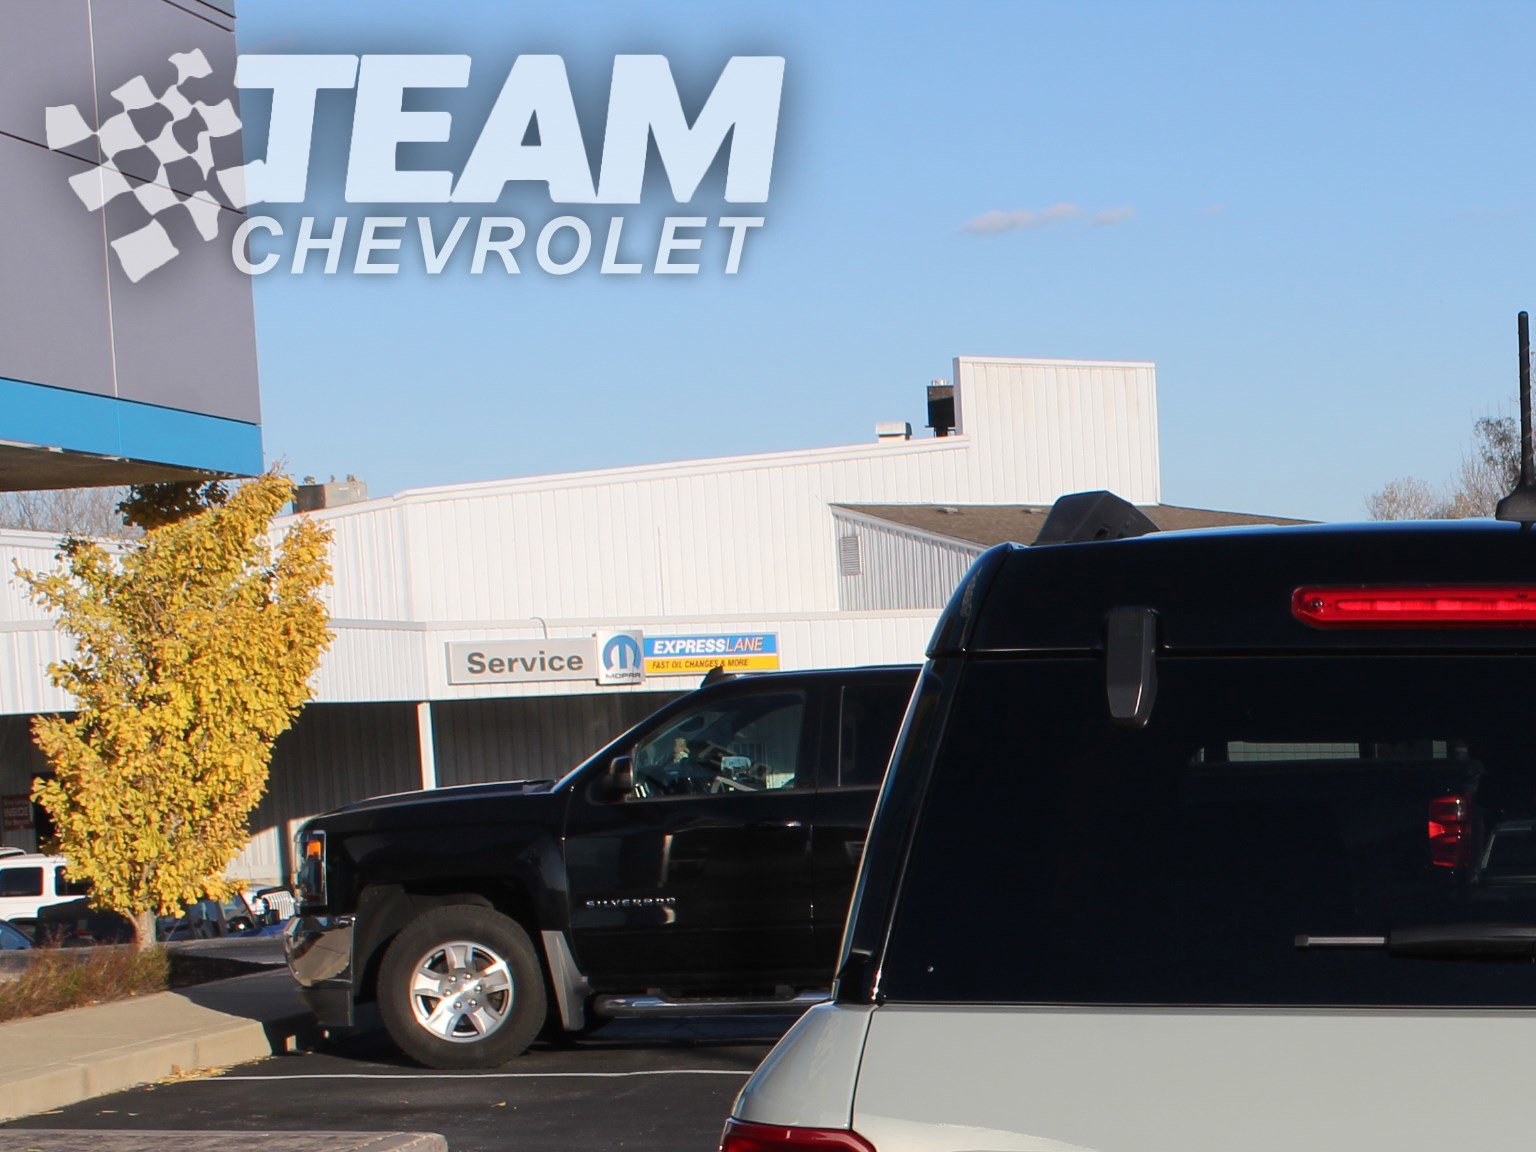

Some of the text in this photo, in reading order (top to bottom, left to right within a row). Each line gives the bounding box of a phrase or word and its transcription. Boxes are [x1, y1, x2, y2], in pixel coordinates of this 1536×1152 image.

[467, 650, 584, 675] Service
[652, 661, 669, 669] FAST
[685, 659, 719, 668] CHANGES
[728, 658, 749, 667] MORE
[605, 671, 641, 679] MOPAR
